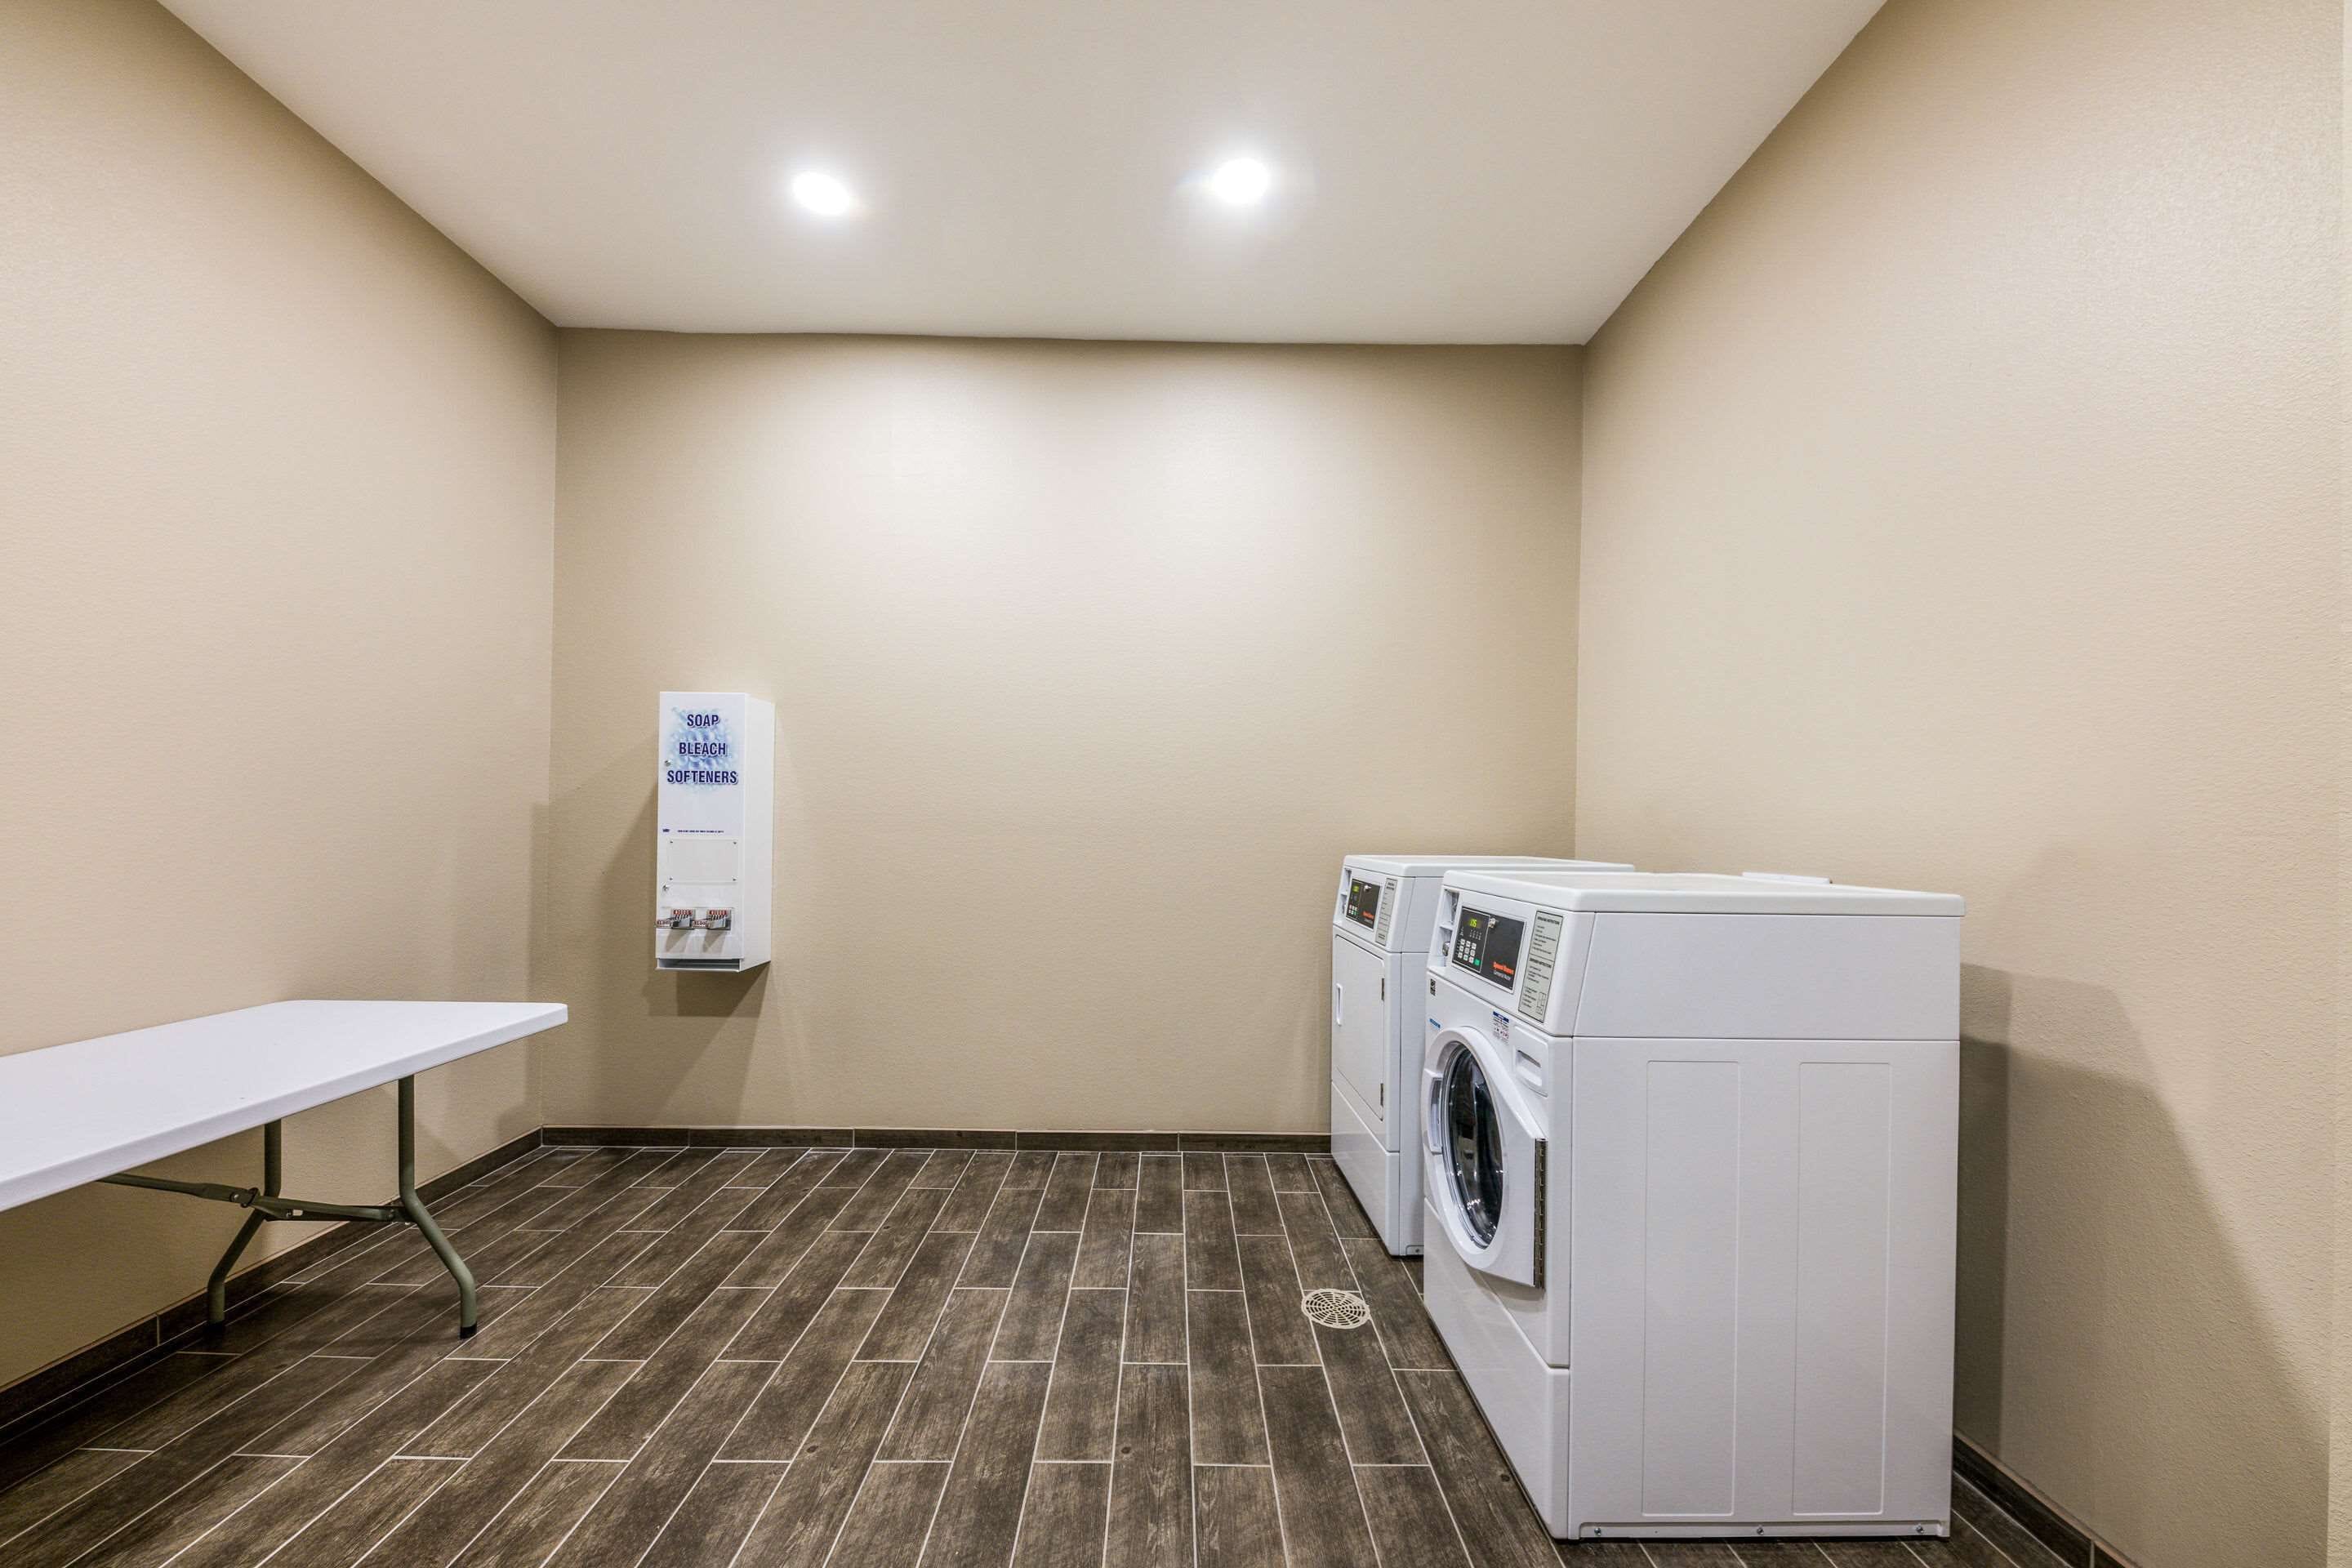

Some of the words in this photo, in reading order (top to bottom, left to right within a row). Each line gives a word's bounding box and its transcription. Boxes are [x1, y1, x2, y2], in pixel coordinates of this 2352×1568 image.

[687, 714, 719, 728] SOAP
[679, 742, 727, 756] BLEACH
[667, 770, 738, 784] SOFTENERS
